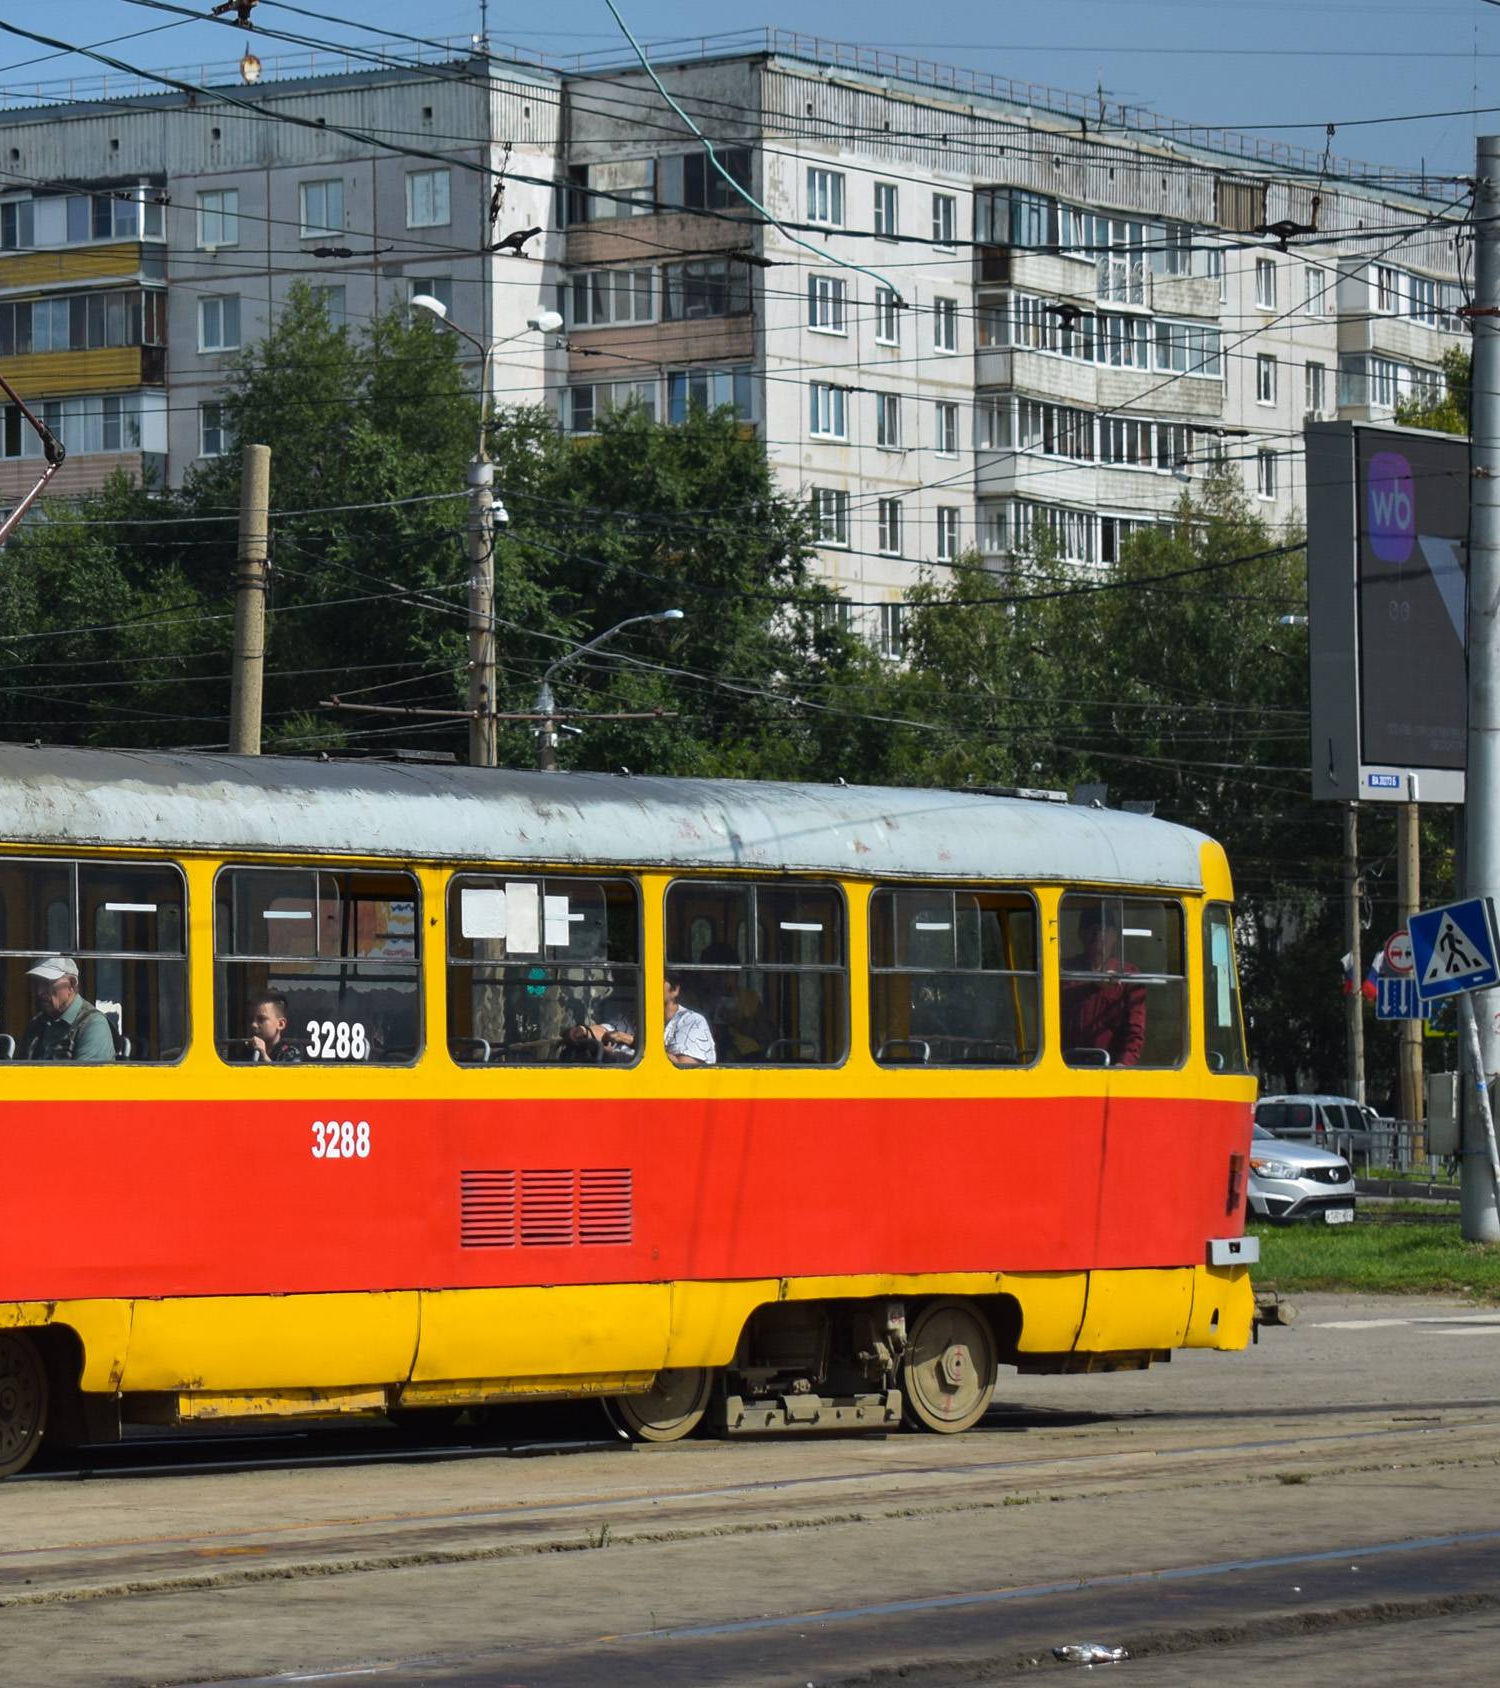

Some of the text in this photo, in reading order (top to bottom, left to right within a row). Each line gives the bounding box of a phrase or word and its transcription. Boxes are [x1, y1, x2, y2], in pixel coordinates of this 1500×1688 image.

[1371, 478, 1412, 531] wb
[306, 1020, 365, 1060] 3288
[311, 1121, 371, 1159] 3288
